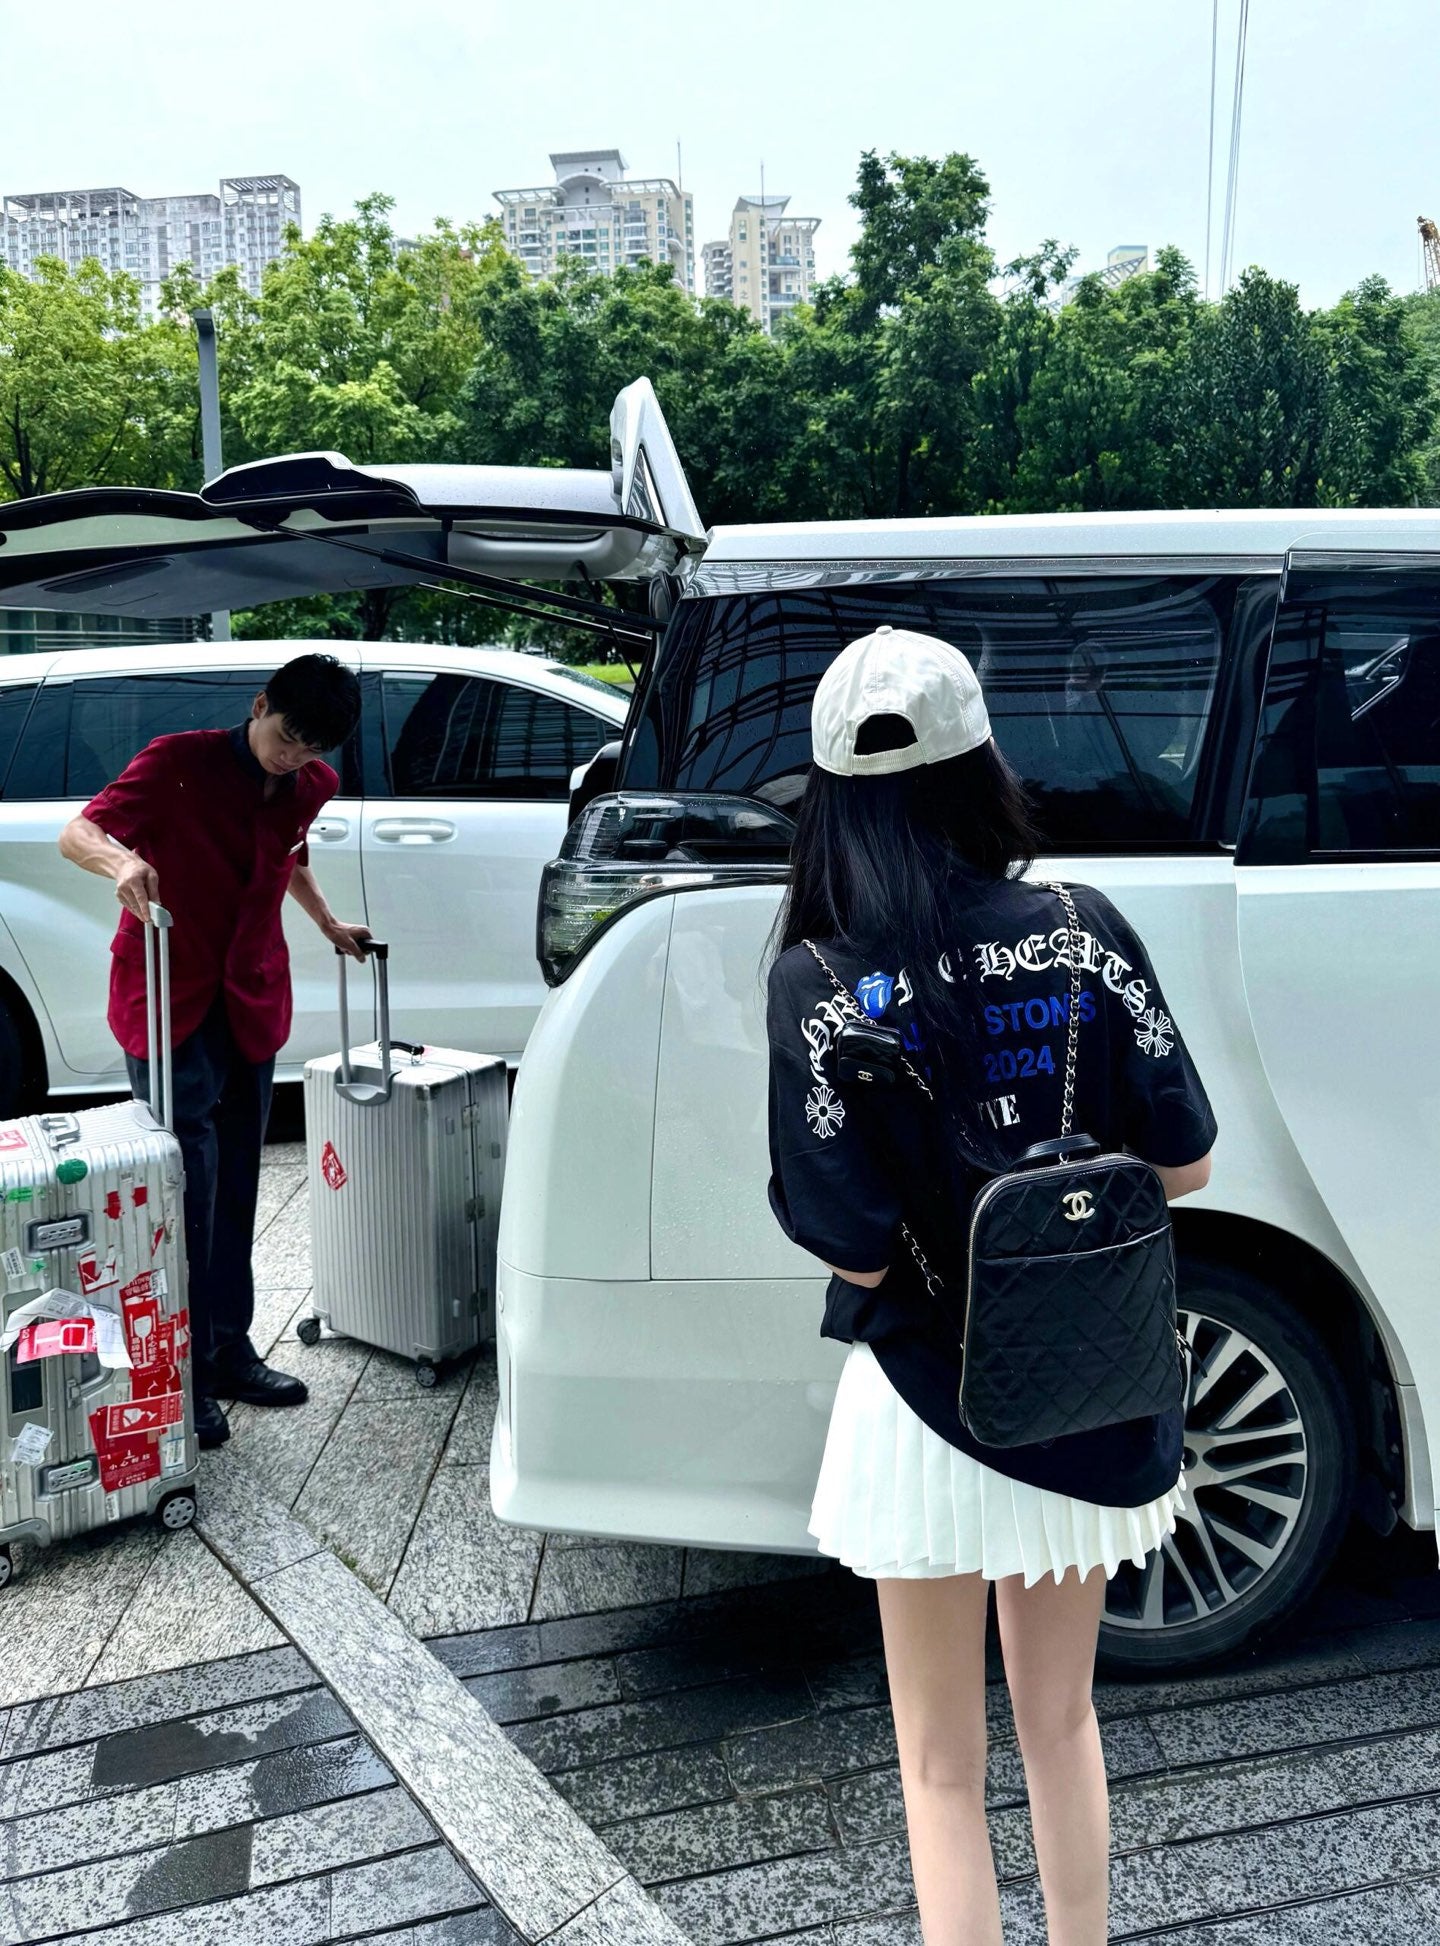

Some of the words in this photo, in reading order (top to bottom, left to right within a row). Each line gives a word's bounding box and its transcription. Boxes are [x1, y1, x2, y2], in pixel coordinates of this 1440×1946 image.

[973, 927, 1152, 1018] HEARTS
[984, 990, 1097, 1035] STONS
[983, 1045, 1056, 1082] 2024
